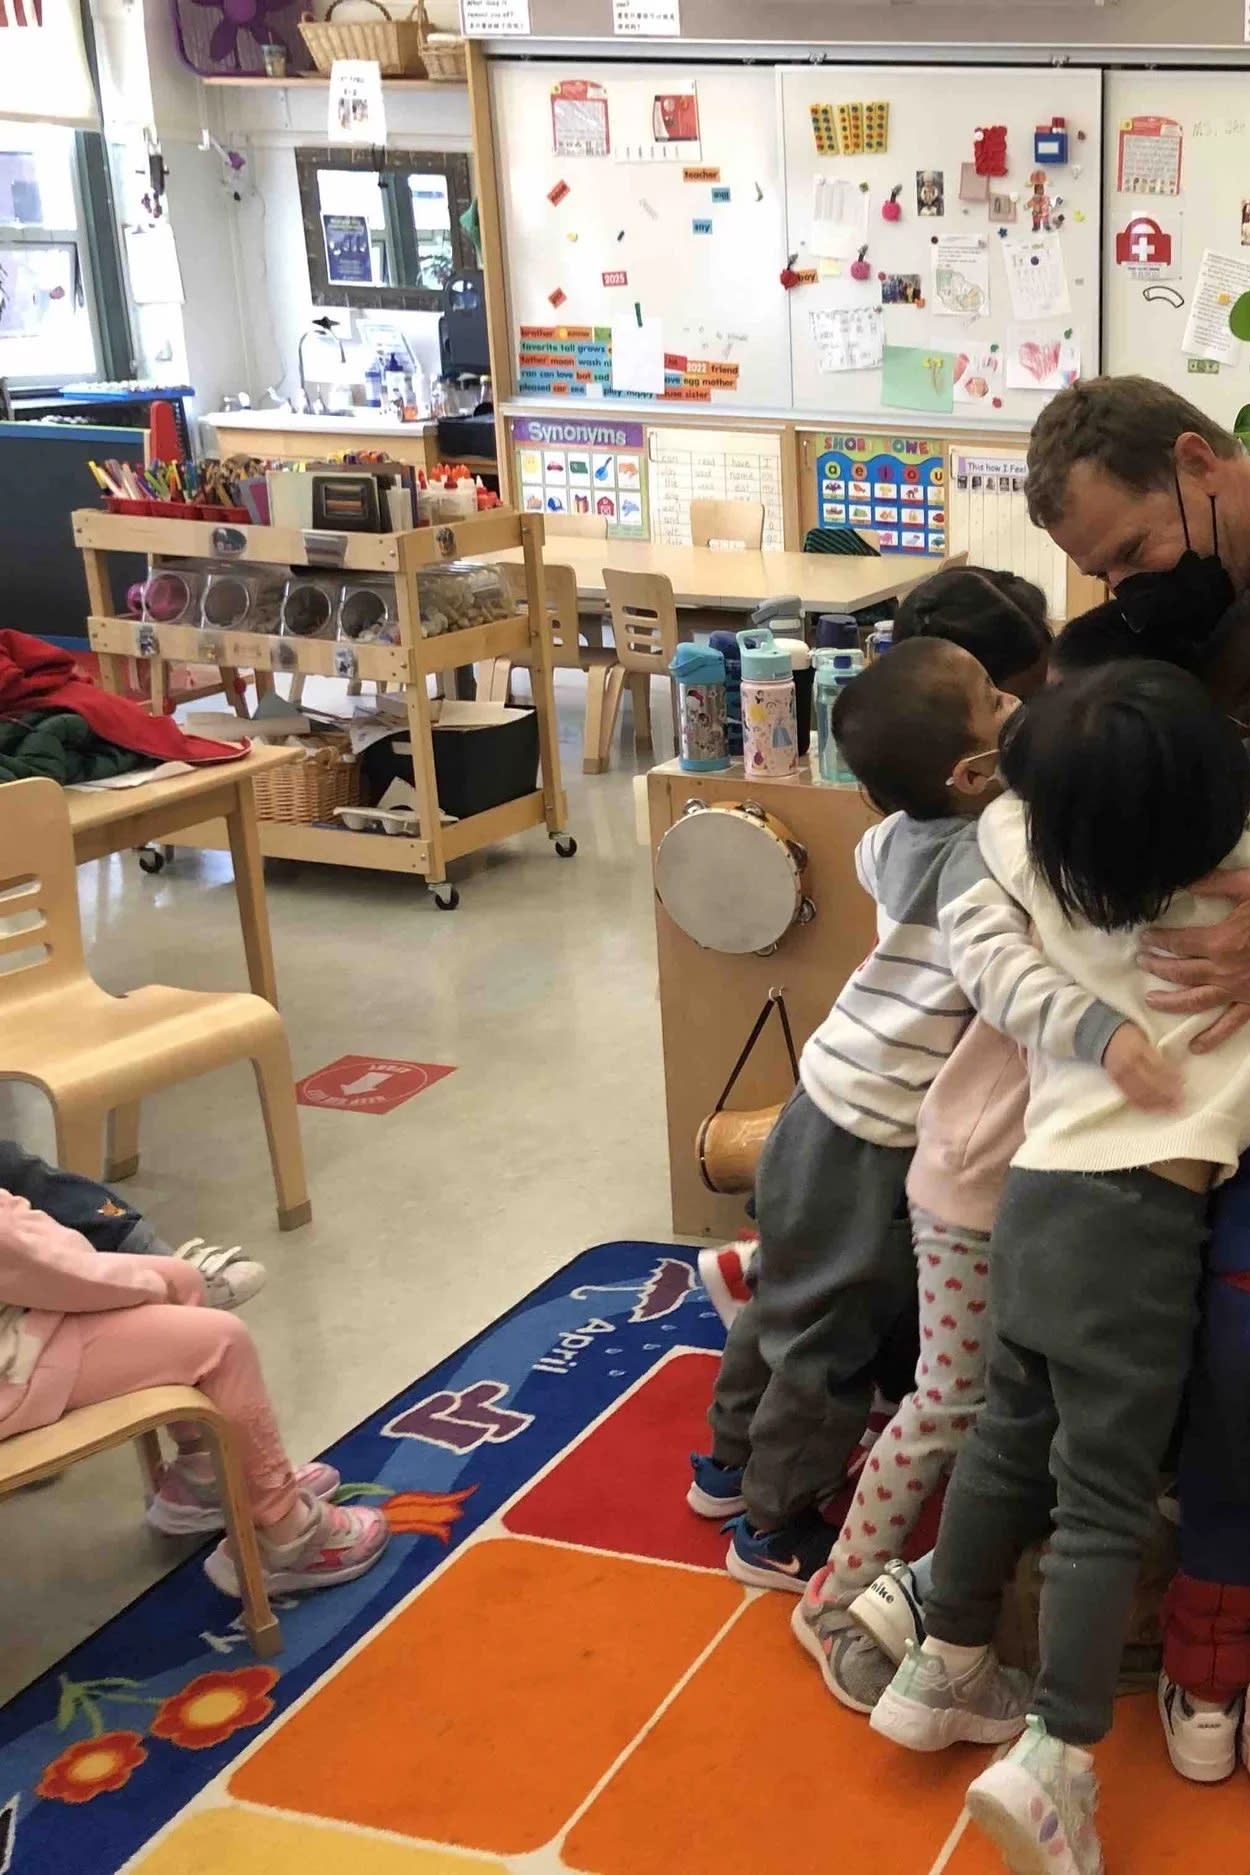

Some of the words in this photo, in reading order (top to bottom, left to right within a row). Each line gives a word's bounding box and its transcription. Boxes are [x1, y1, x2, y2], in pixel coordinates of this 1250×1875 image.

[684, 169, 718, 180] teacher
[694, 223, 711, 233] any
[604, 273, 626, 285] 2025
[522, 342, 558, 352] favorite
[560, 343, 576, 352] tall
[577, 345, 605, 354] grows
[550, 358, 575, 366] moon
[578, 358, 602, 366] wash
[521, 370, 537, 378] ran
[556, 369, 574, 378] love
[710, 364, 738, 374] friend
[683, 378, 700, 387] egg
[702, 377, 734, 387] mother
[528, 421, 627, 447] Synonyms
[828, 464, 838, 475] a
[855, 466, 864, 477] e
[967, 461, 984, 471] This
[986, 463, 1001, 473] how
[1003, 463, 1008, 473] I
[1009, 463, 1026, 474] Feel
[907, 469, 916, 480] o
[934, 471, 943, 481] u
[531, 1317, 616, 1375] April
[870, 1582, 894, 1604] nike
